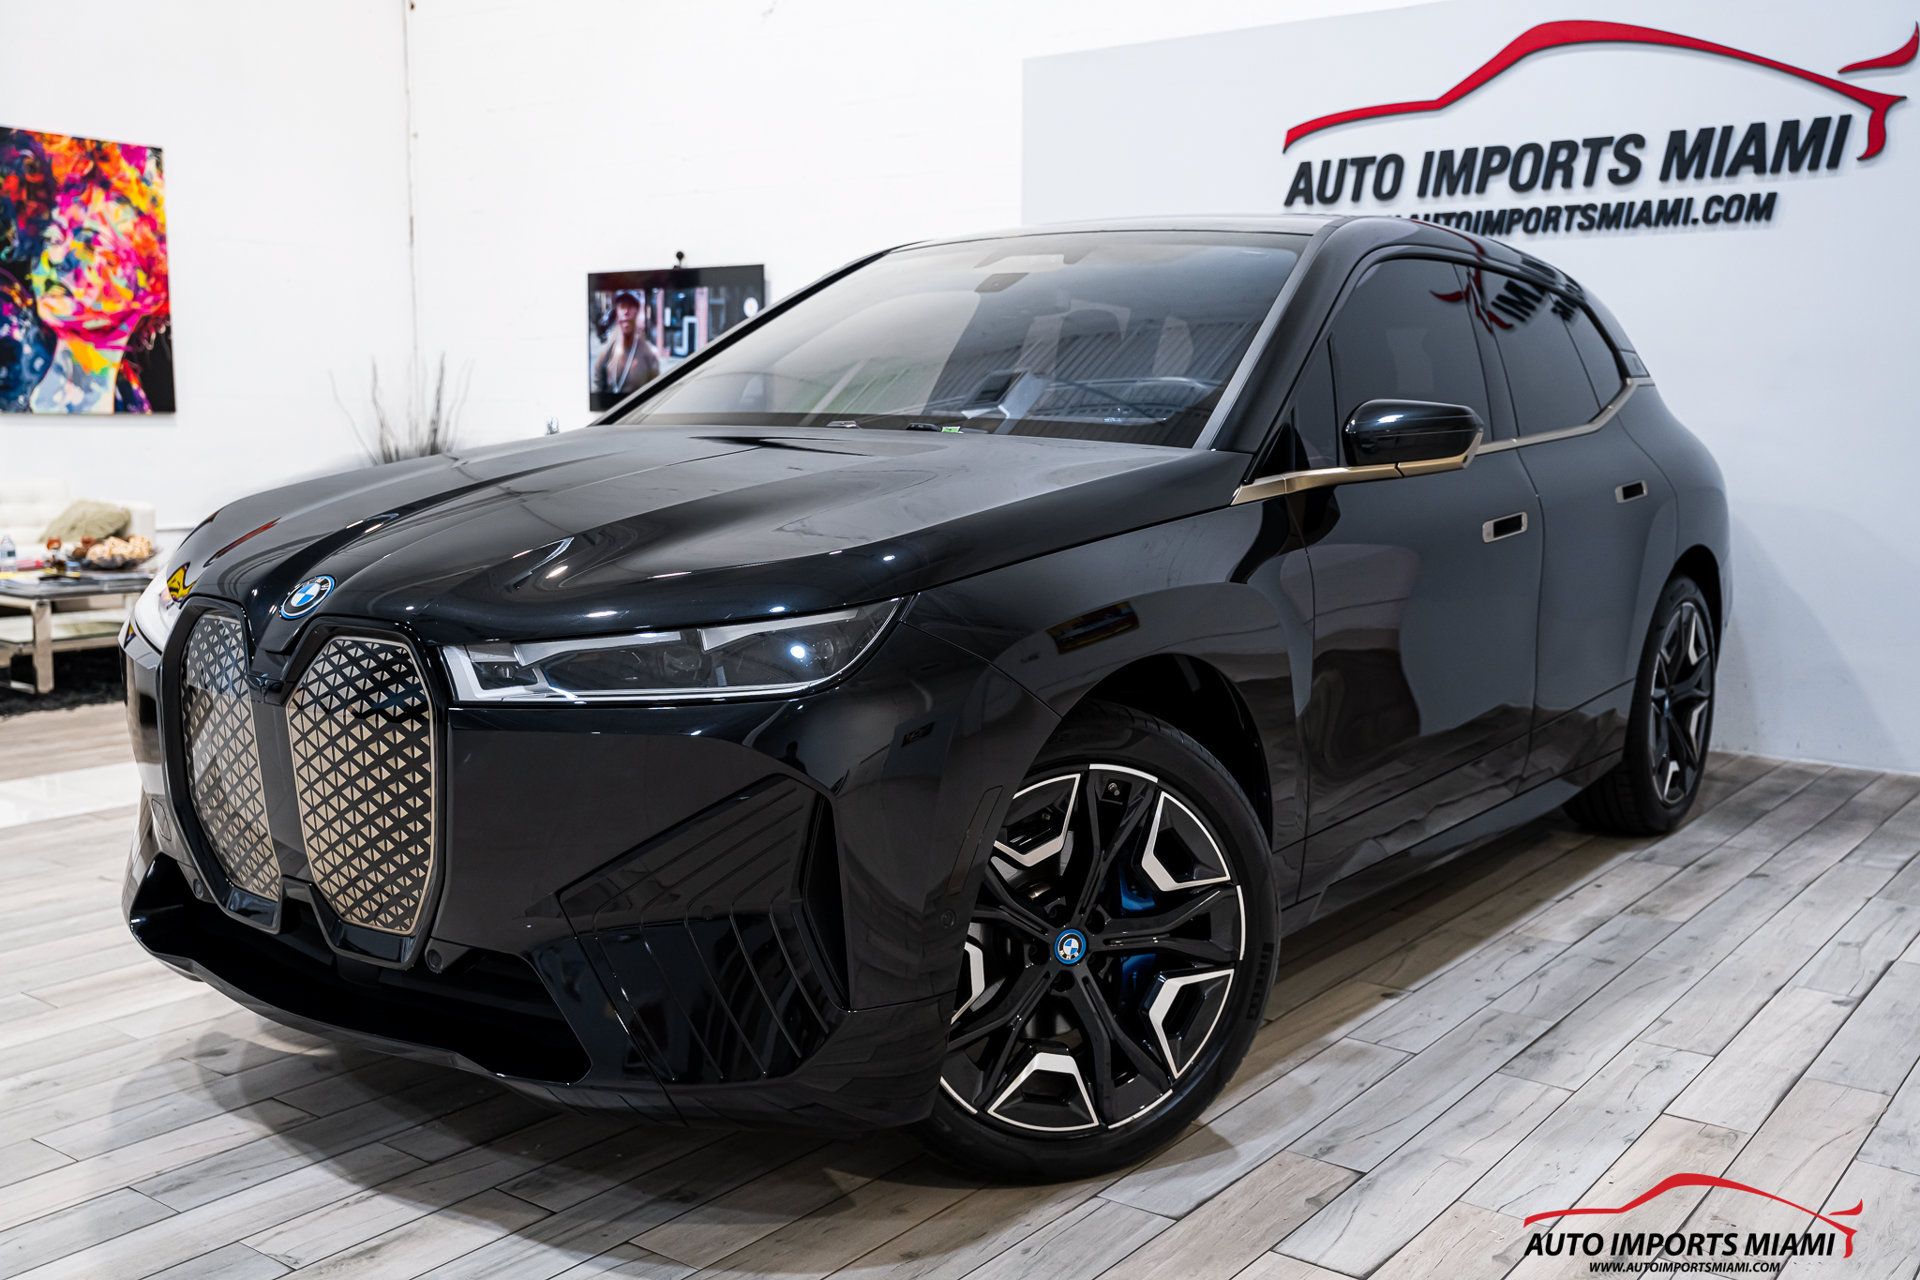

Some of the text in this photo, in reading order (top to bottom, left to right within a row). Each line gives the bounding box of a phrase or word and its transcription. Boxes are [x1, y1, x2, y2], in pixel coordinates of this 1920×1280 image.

[1284, 114, 1853, 207] AUTO IMPORTS MIAMI
[1410, 192, 1778, 236] TOIMPORTSMIAMI.COM
